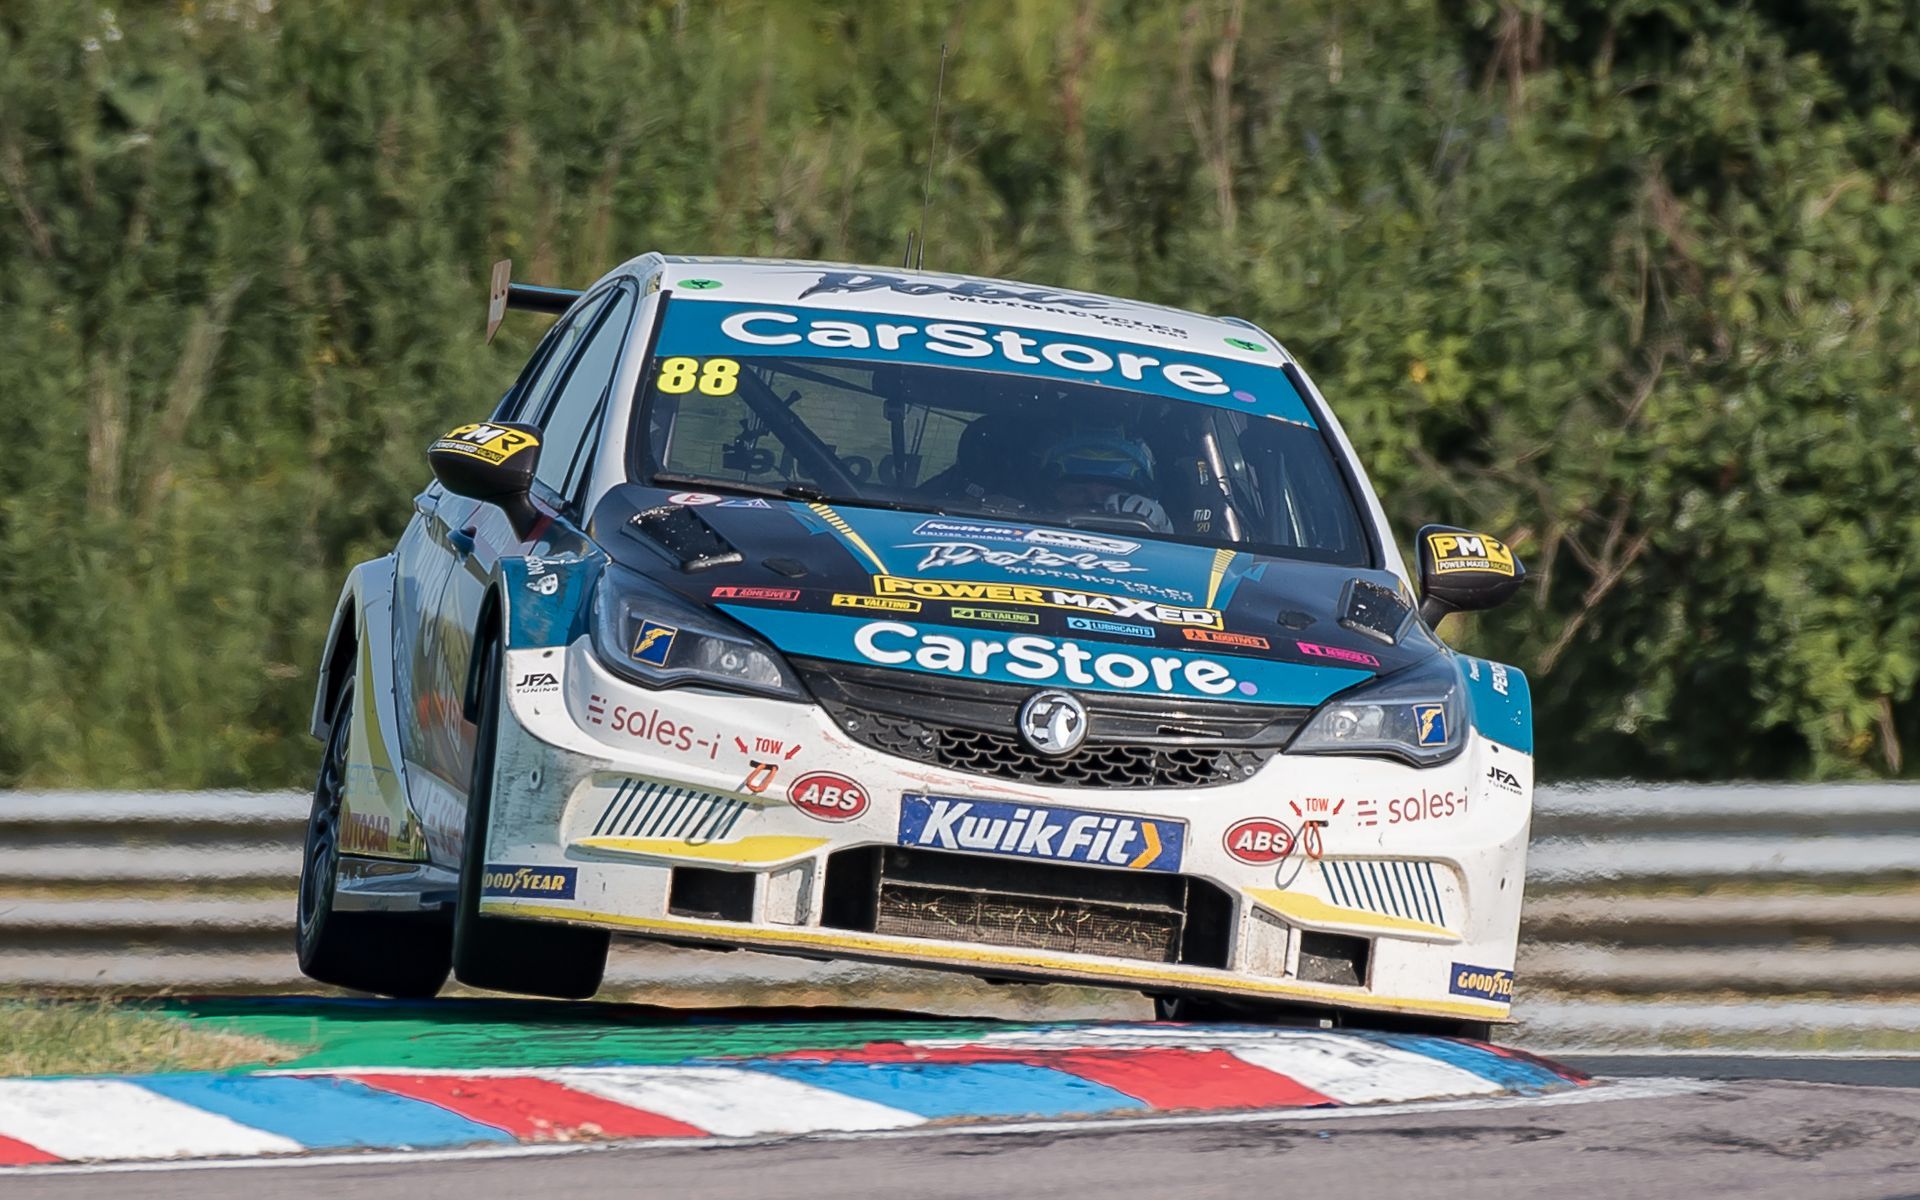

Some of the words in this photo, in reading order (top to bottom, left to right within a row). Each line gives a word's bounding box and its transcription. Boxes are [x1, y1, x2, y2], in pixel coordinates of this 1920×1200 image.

[949, 296, 1187, 334] MOTORCYCLES
[656, 358, 740, 395] 88
[443, 423, 527, 452] PMR
[883, 578, 1045, 602] POWER
[1052, 591, 1214, 624] MAXED
[980, 612, 1030, 623] DETAILING
[1091, 622, 1152, 636] LUBRICANTS
[516, 673, 559, 687] JFA
[610, 705, 721, 760] sales-i
[755, 737, 784, 755] TOW
[1487, 767, 1522, 789] JFA
[799, 783, 859, 811] ABS
[1305, 798, 1329, 812] TOW
[1388, 787, 1468, 824] sales-i
[1235, 829, 1289, 853] ABS
